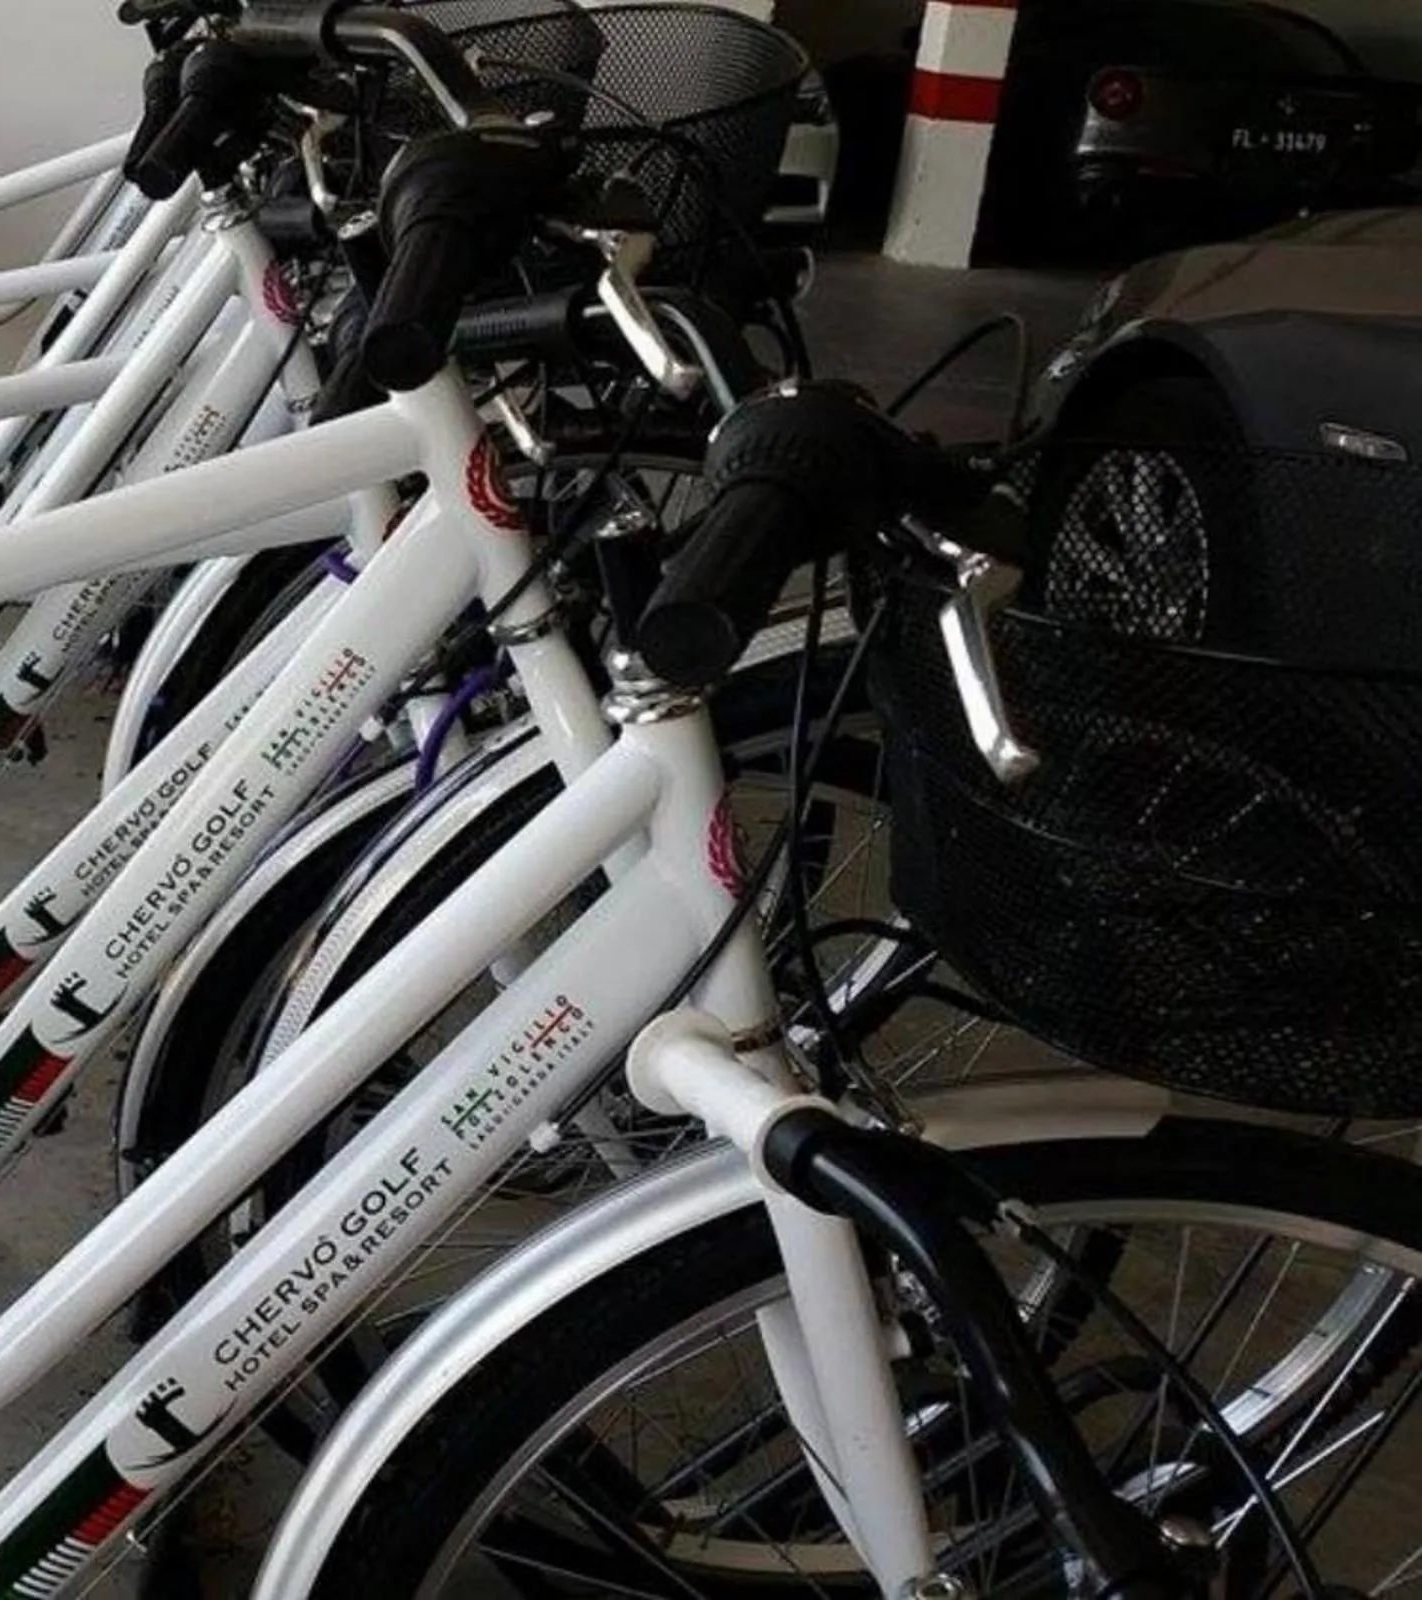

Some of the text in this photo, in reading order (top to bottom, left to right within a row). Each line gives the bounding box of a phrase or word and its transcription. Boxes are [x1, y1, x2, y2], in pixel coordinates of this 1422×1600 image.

[157, 742, 211, 798] GOLF
[192, 778, 250, 852] GOLF
[116, 920, 171, 979] HOTEL
[441, 1087, 478, 1125] SAN
[340, 1147, 420, 1237] GOLF
[224, 1320, 302, 1391] HOTEL
